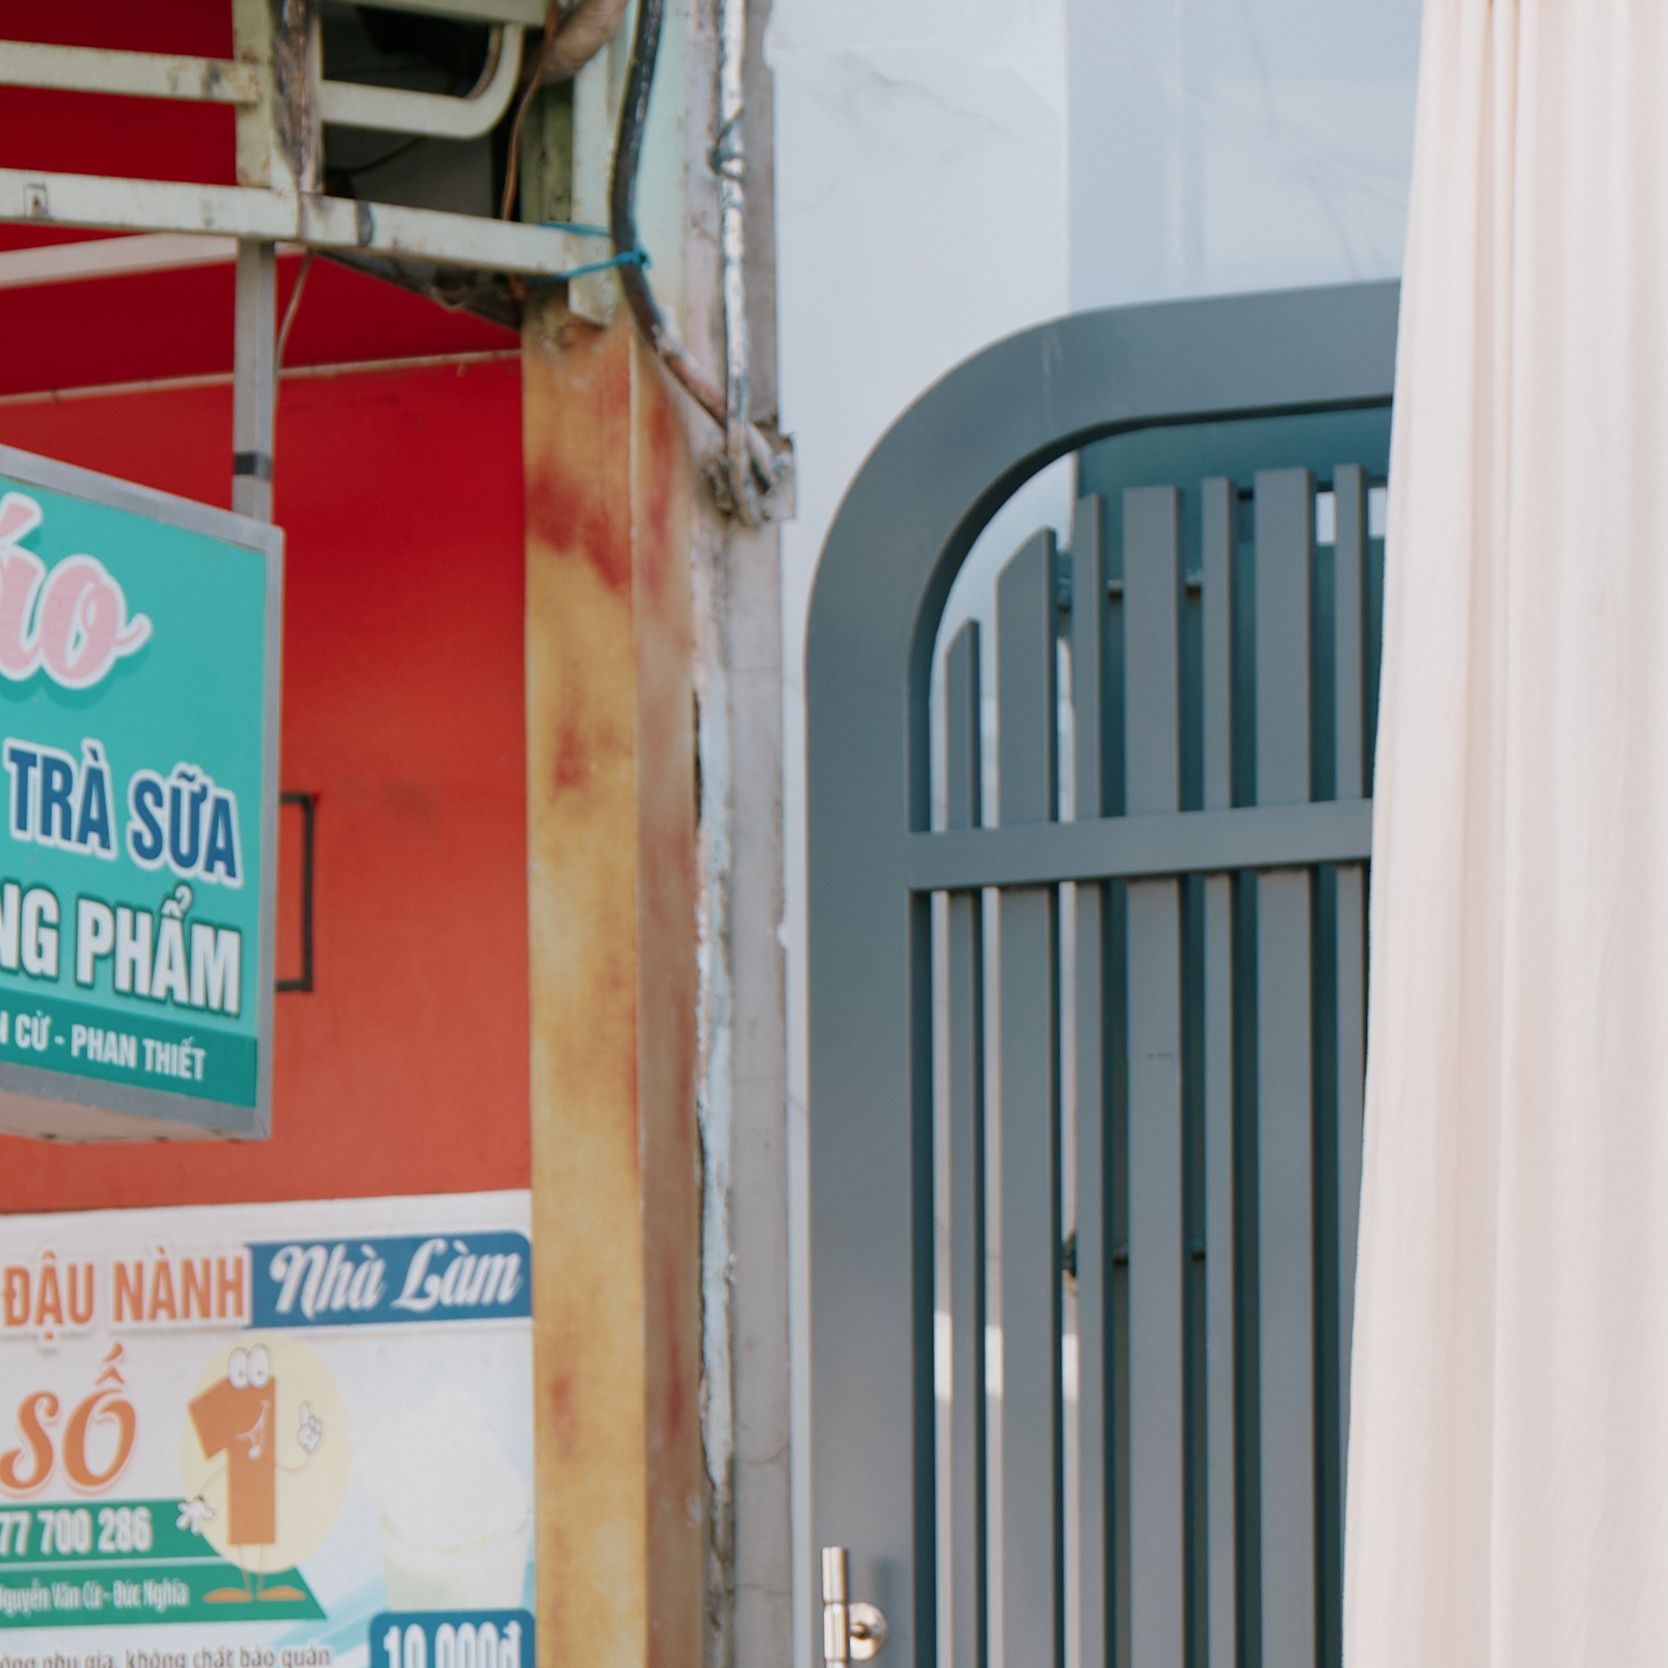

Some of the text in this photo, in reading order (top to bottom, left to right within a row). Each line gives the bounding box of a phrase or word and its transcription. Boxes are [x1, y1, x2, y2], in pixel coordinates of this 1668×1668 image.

[7, 743, 241, 884] TRÀ SỮA
[75, 885, 242, 1015] PHẨM
[71, 1023, 138, 1070] PHAN
[142, 1035, 208, 1082] THIẾT
[3, 1237, 523, 1341] ĐẬU NÀNH Nhà Làm
[37, 1507, 93, 1555] 700
[98, 1505, 153, 1552] 286
[193, 1645, 234, 1668] chất
